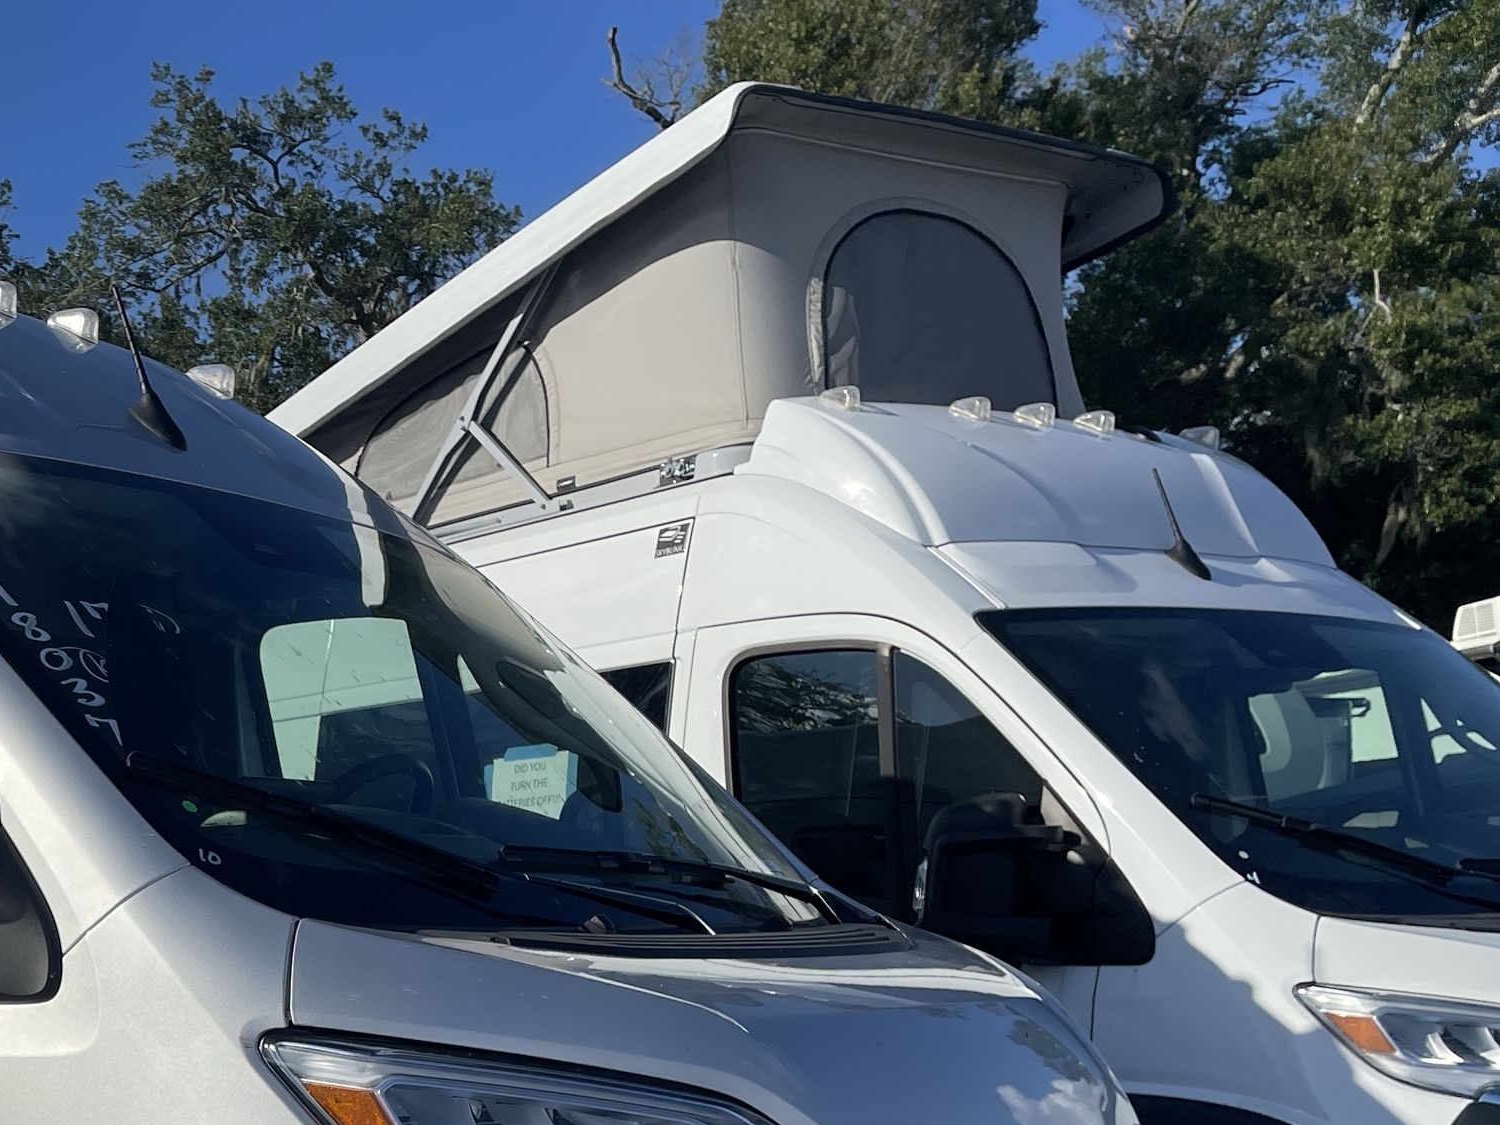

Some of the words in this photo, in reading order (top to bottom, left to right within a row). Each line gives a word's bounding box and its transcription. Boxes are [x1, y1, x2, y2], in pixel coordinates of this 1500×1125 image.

[514, 763, 529, 774] DID
[530, 761, 546, 771] YOU
[510, 780, 531, 791] TURN
[533, 778, 548, 789] THE
